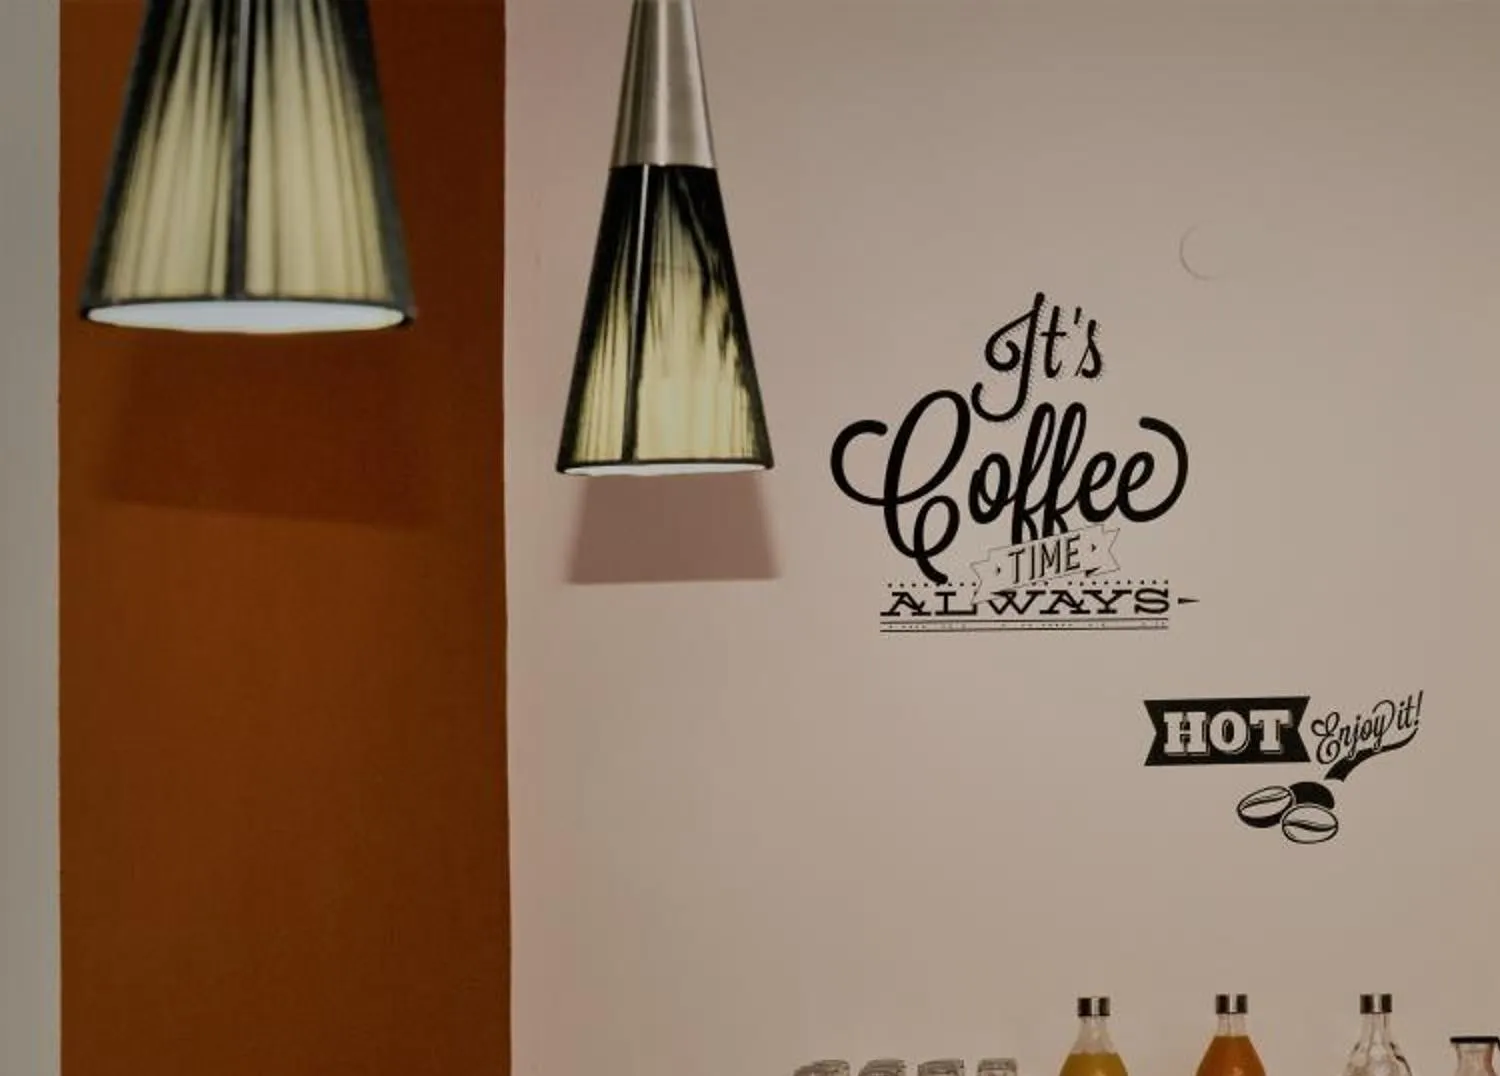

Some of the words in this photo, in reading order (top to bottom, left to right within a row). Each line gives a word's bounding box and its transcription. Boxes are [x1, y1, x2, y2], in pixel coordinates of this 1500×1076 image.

[971, 292, 1105, 422] It's
[830, 389, 1189, 584] Coffee
[1007, 534, 1083, 586] TIME
[880, 588, 1170, 616] ALWAYS
[1163, 709, 1293, 758] HOT
[1311, 699, 1395, 765] Enjoy
[1397, 690, 1424, 731] it!
